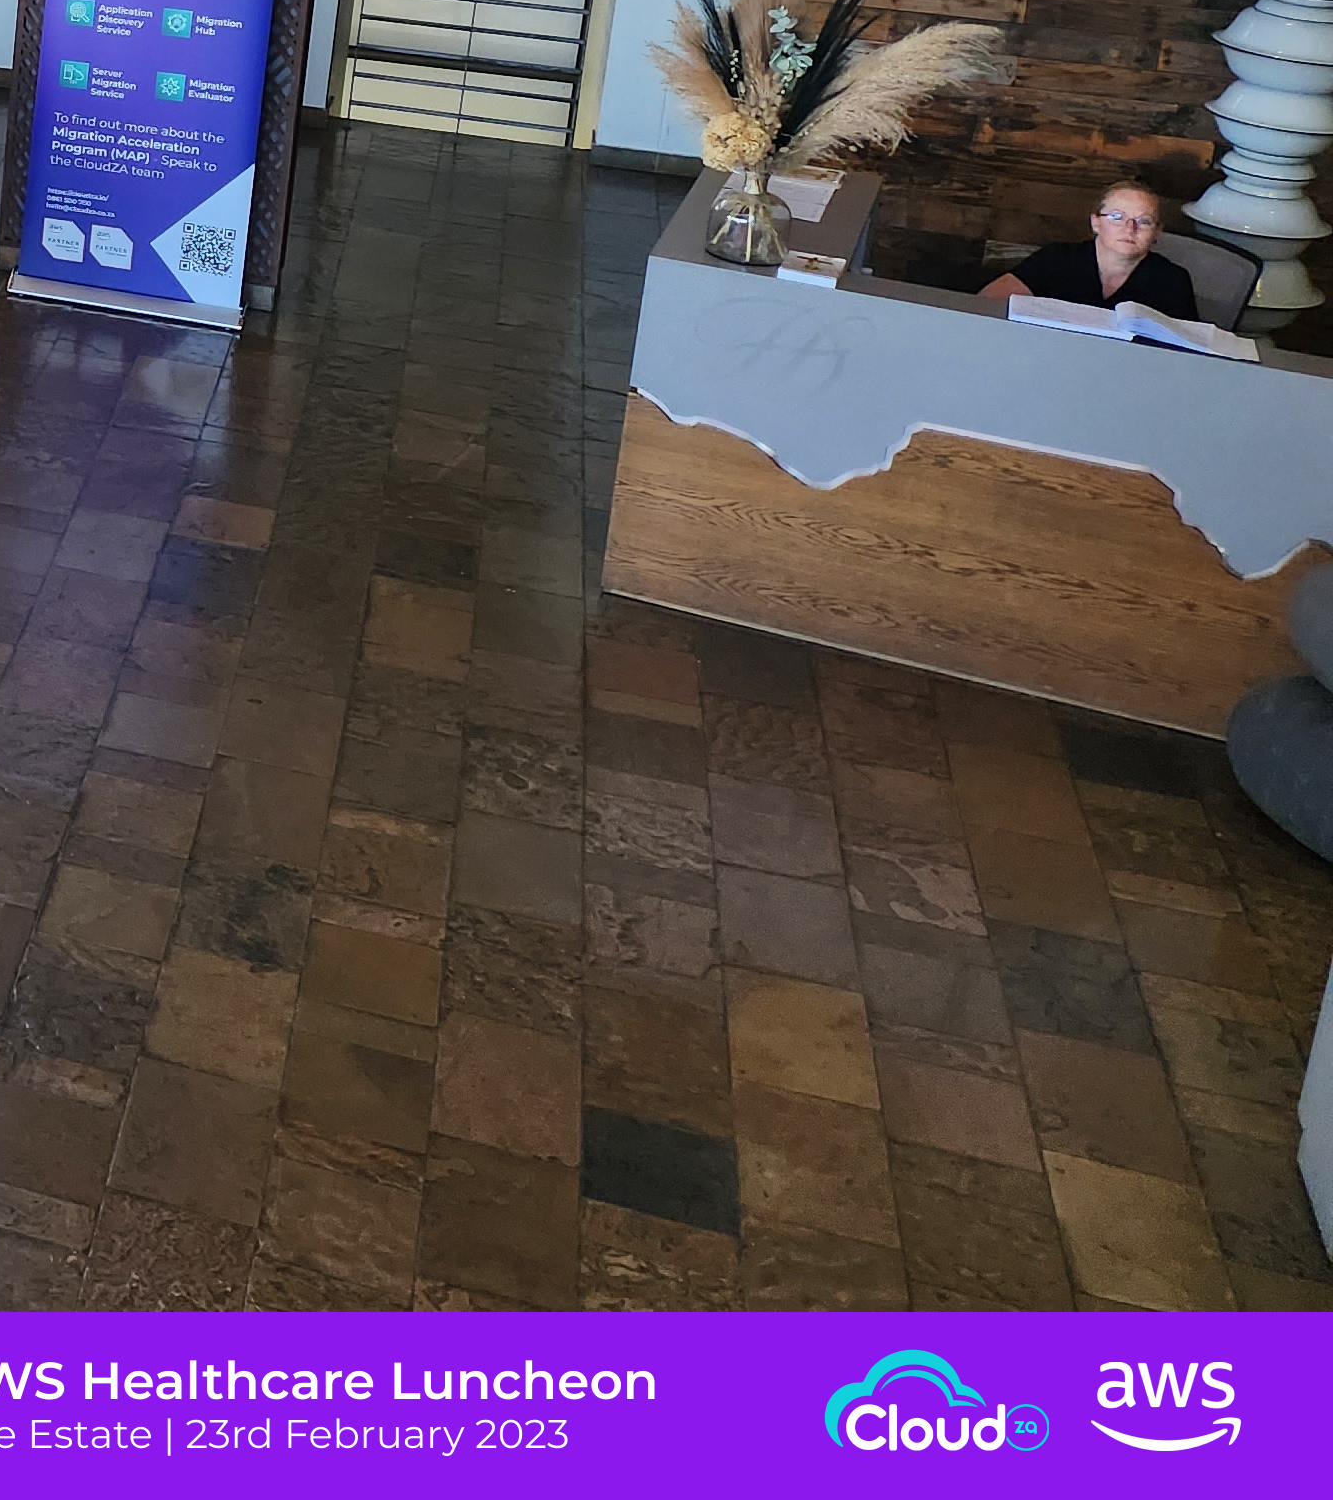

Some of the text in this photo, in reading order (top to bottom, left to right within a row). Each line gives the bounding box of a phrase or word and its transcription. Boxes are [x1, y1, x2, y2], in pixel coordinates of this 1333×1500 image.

[98, 4, 153, 18] Application
[98, 15, 144, 28] Discovery
[196, 15, 243, 29] Migration
[97, 25, 131, 37] Service
[195, 26, 216, 36] Hub
[92, 67, 123, 78] Server
[91, 78, 137, 91] Migration
[189, 79, 235, 93] Migration
[90, 88, 125, 99] Service
[188, 90, 234, 103] Evaluator
[54, 112, 225, 144] To find out more about the
[52, 126, 200, 155] Migration Acceleration
[52, 140, 217, 172] Program (MAP) Speak to
[50, 154, 165, 179] the CloudZA team
[47, 237, 79, 246] PARTNER
[95, 245, 127, 254] PARTNER
